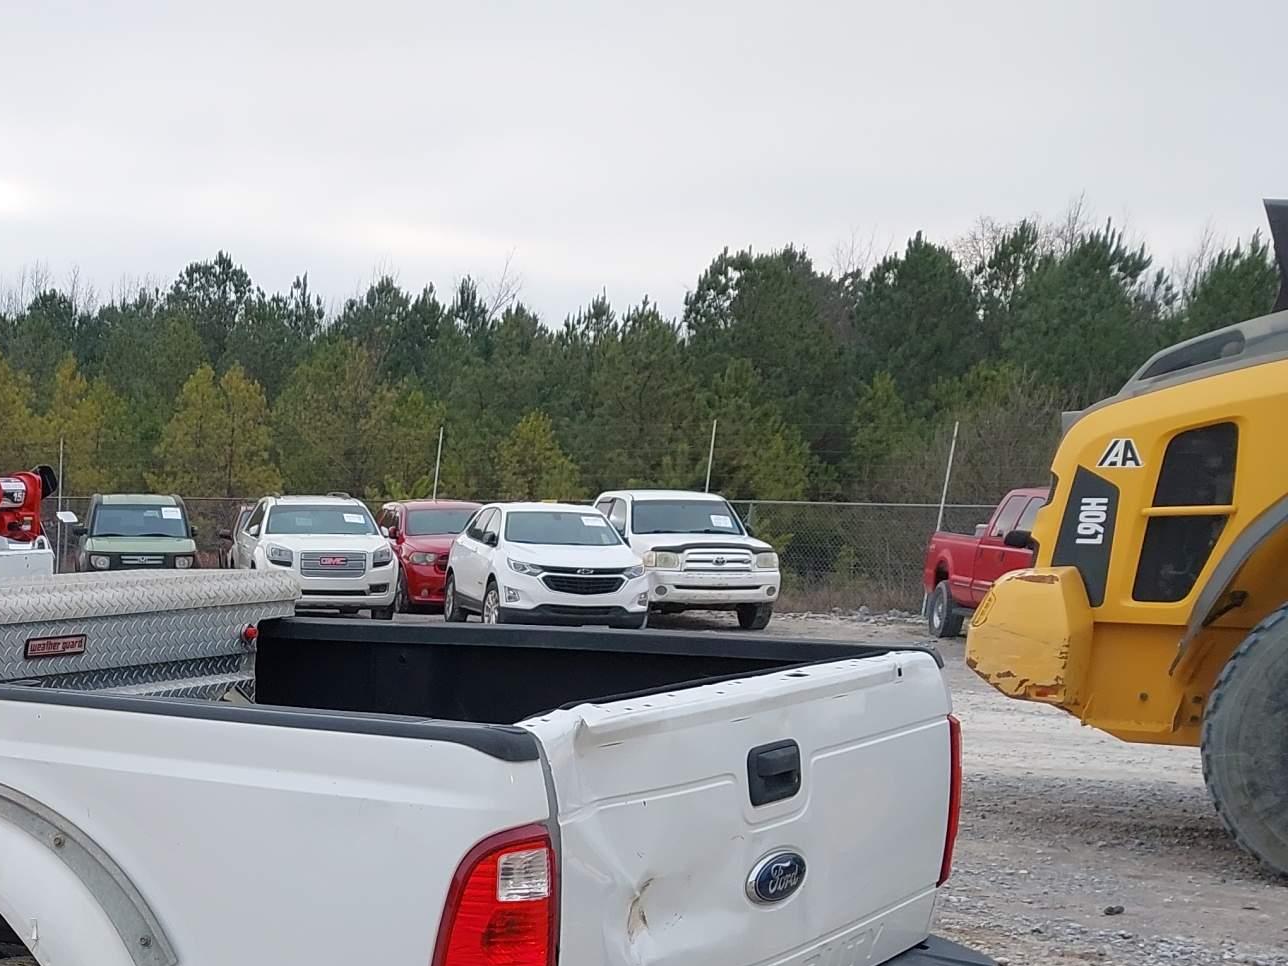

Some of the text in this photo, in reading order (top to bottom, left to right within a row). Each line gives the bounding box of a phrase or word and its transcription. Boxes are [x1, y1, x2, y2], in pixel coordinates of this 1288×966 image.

[1075, 498, 1109, 545] L90H
[320, 557, 347, 565] GMC
[768, 860, 799, 894] Ford
